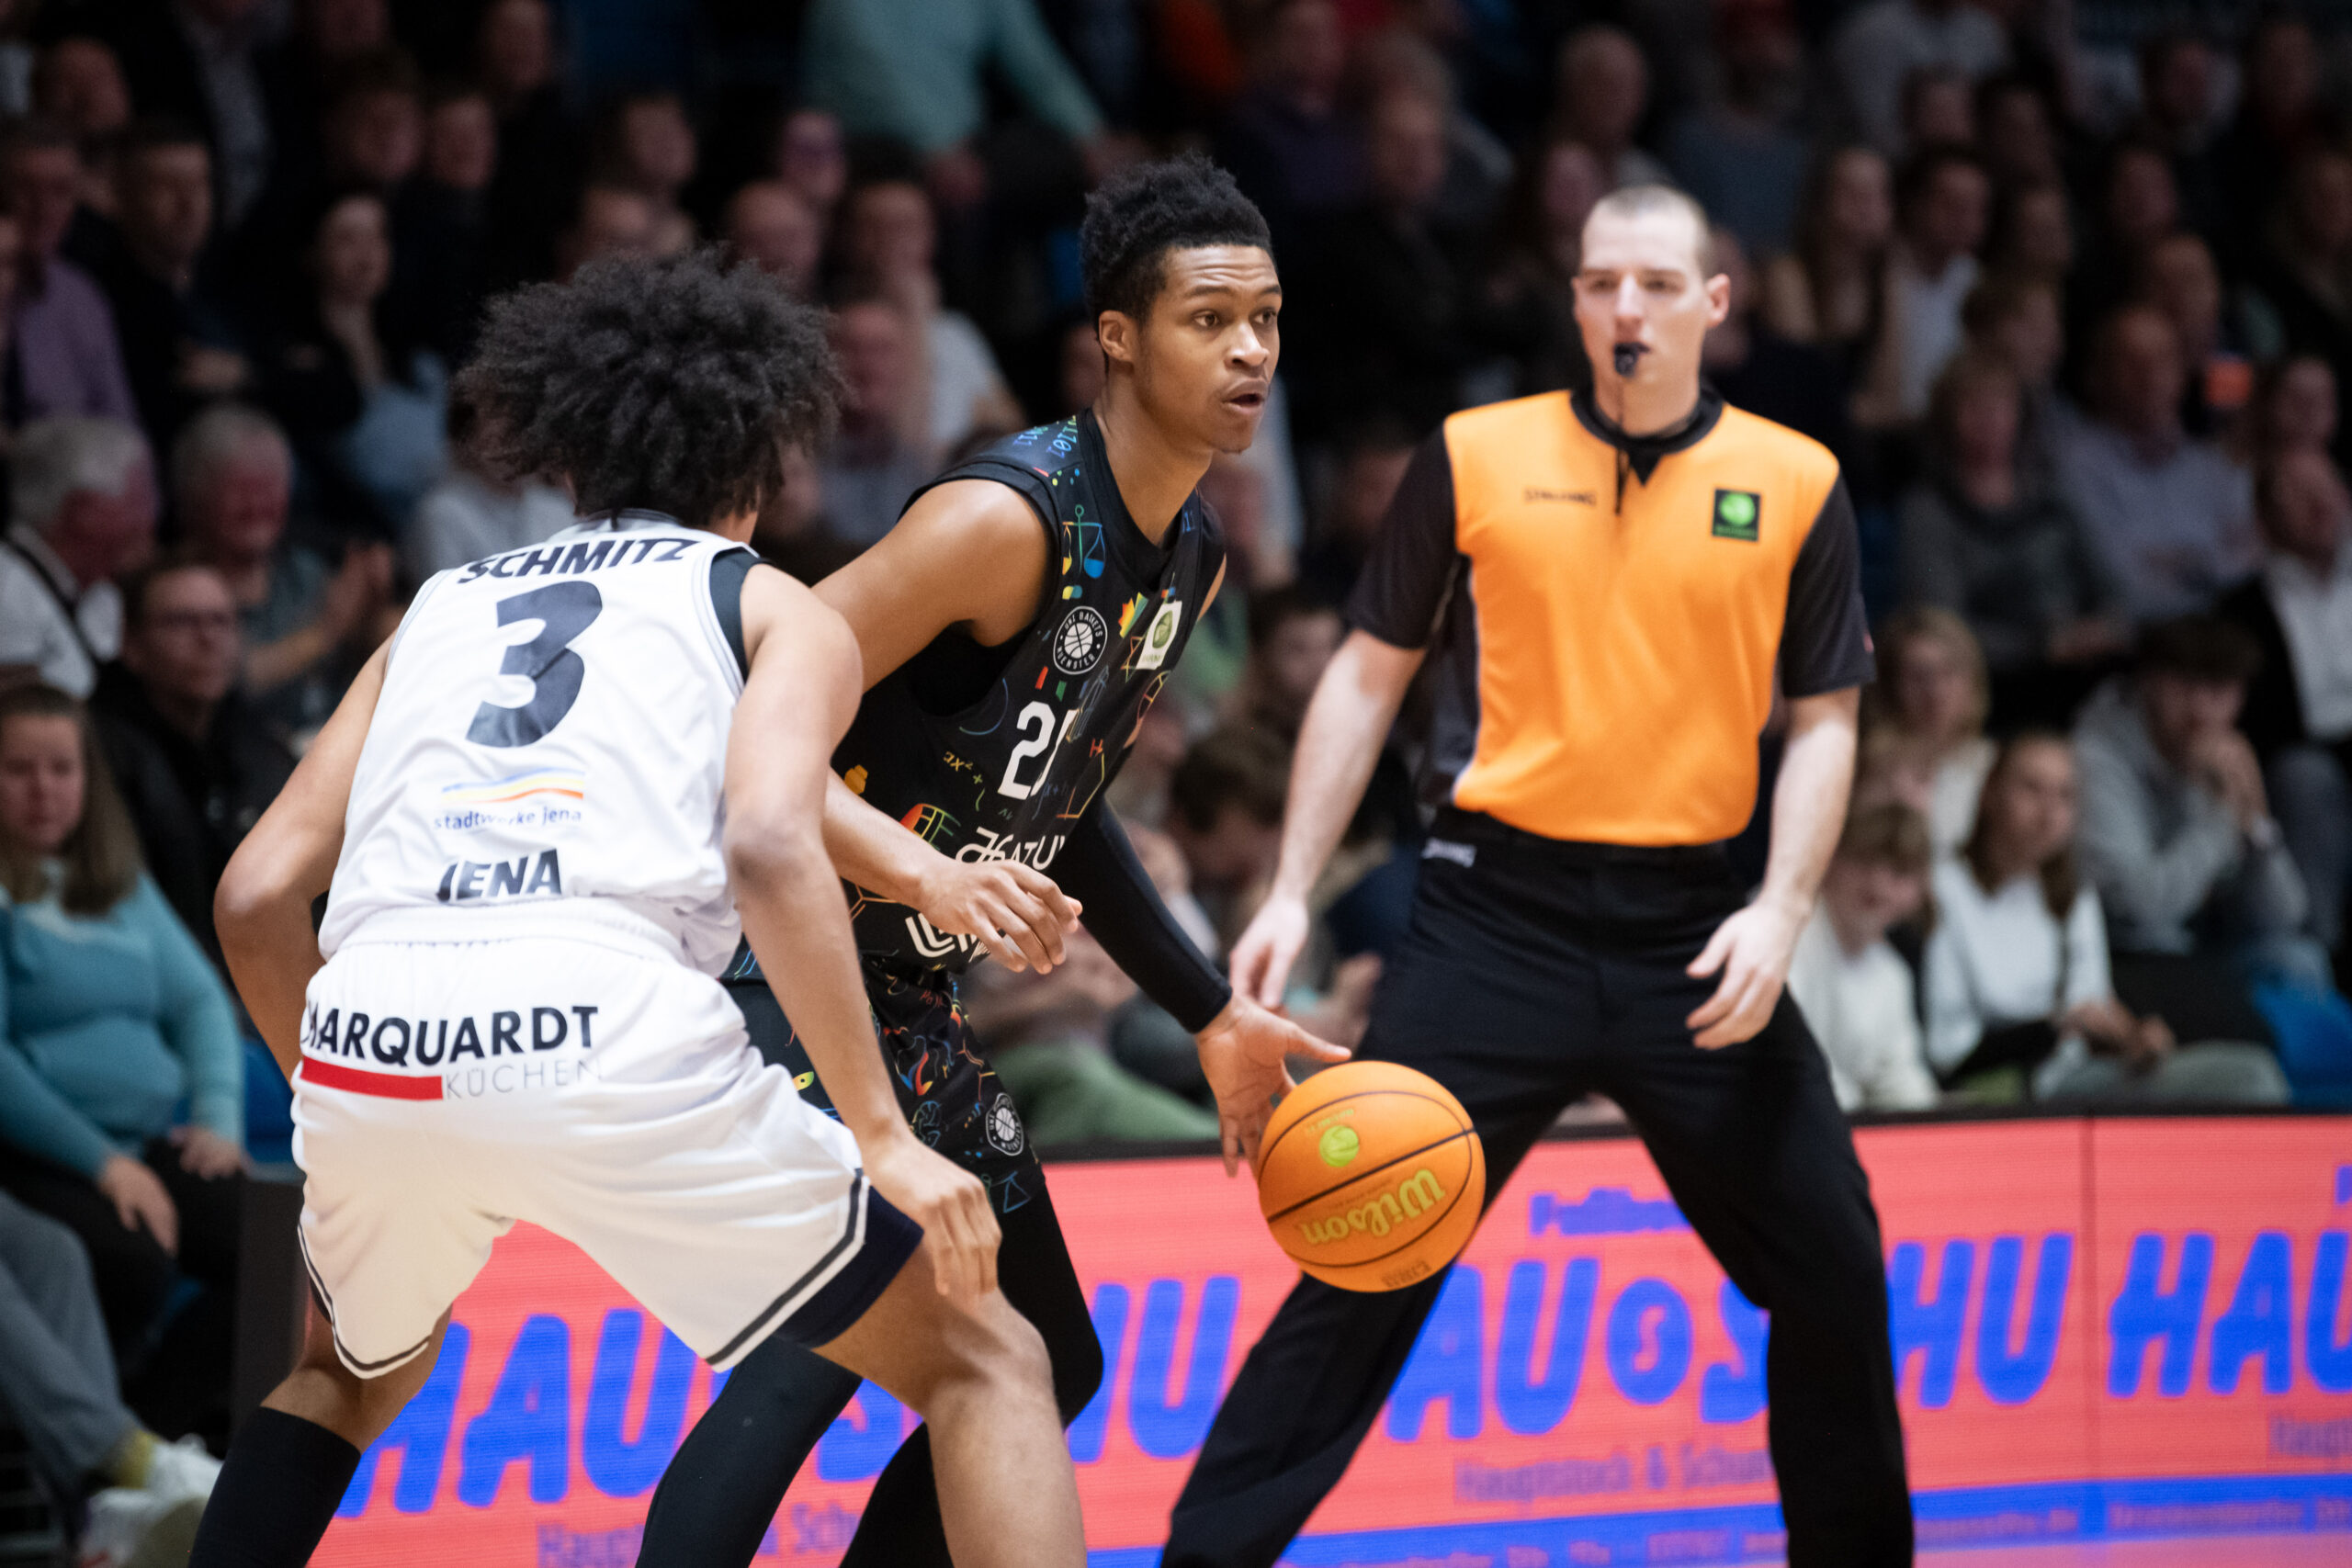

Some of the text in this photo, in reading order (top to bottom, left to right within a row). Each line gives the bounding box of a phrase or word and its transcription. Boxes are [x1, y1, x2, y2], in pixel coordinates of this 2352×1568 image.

[458, 538, 700, 583] SCHMITZ
[466, 581, 602, 748] 3
[543, 806, 582, 826] jena
[436, 848, 562, 903] JENA
[446, 1059, 603, 1100] KÜCHEN
[1300, 1168, 1446, 1246] Wilson
